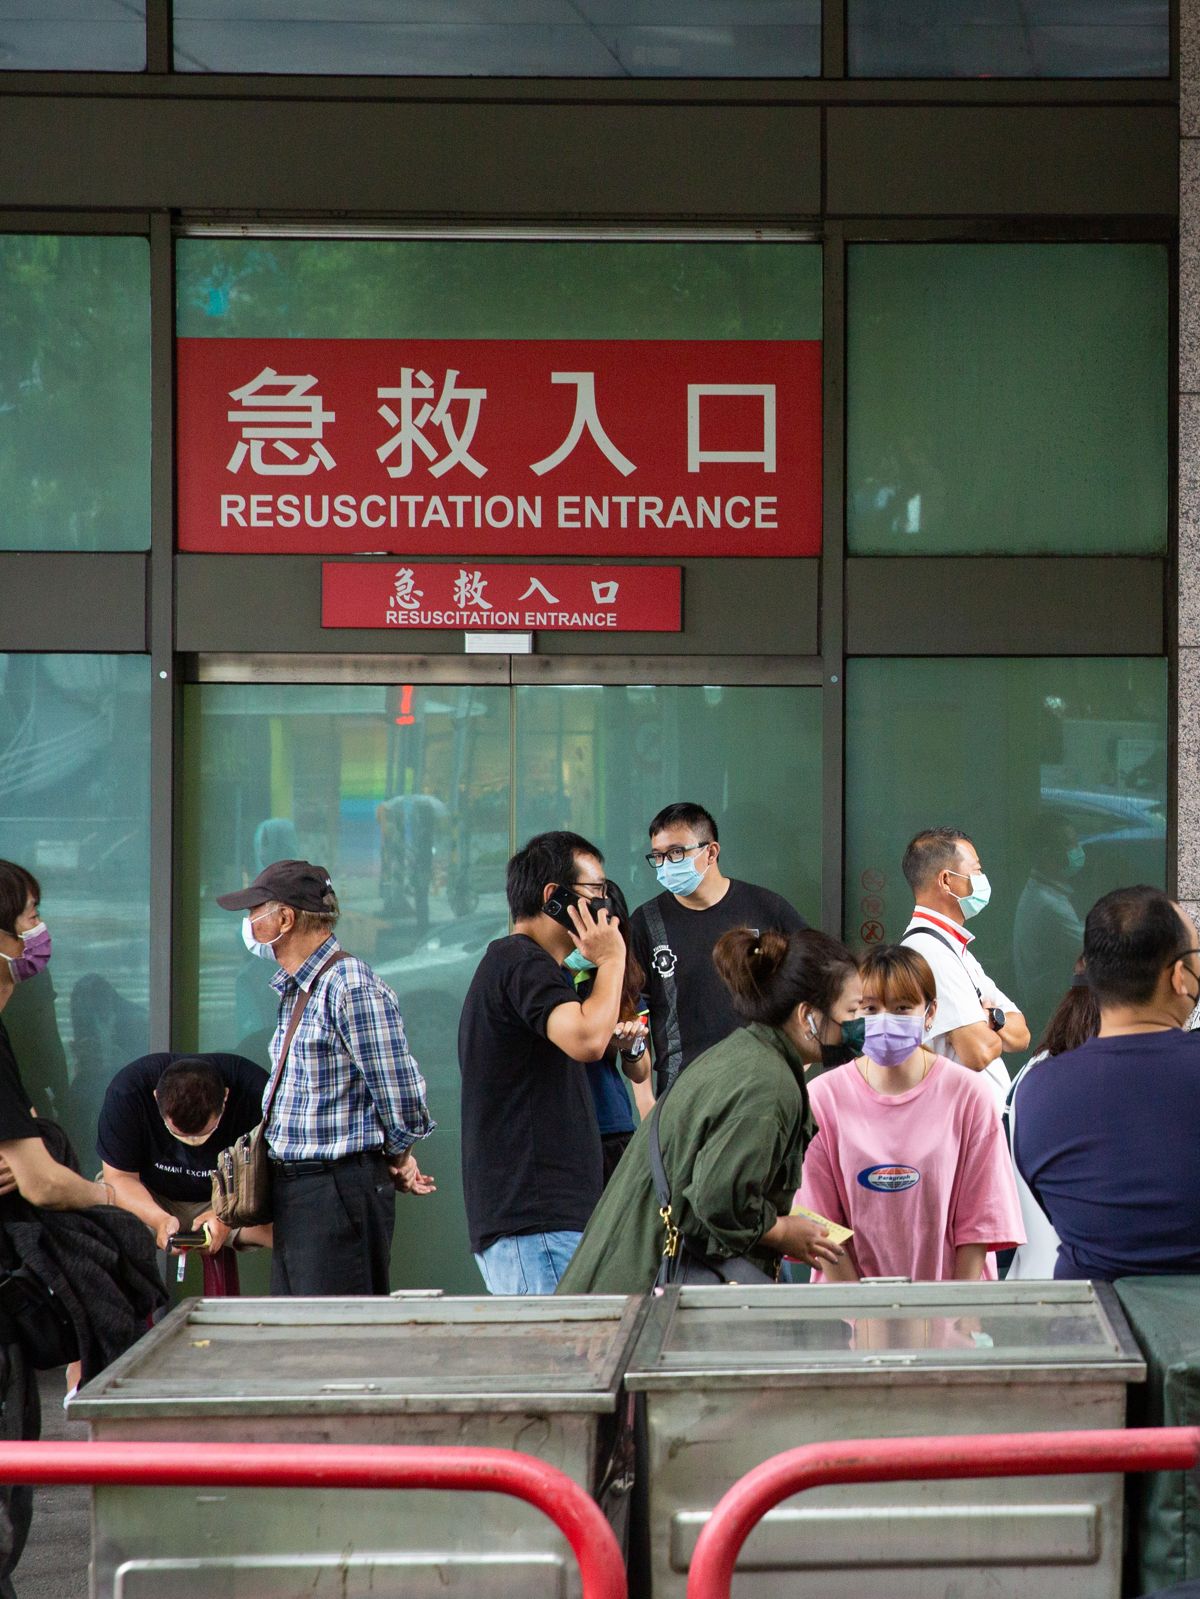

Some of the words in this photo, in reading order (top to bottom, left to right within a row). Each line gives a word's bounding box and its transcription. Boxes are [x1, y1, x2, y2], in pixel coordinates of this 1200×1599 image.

[226, 367, 776, 478] 急救入口
[221, 495, 541, 528] RESUSCITATION
[558, 496, 777, 528] ENTRANCE
[390, 568, 618, 609] 急救入口
[387, 611, 519, 625] RESUSCITATION
[525, 612, 616, 626] ENTRANCE
[154, 1162, 183, 1174] ARMANI
[186, 1168, 214, 1178] EXCHA
[877, 1174, 911, 1182] Paragraph
